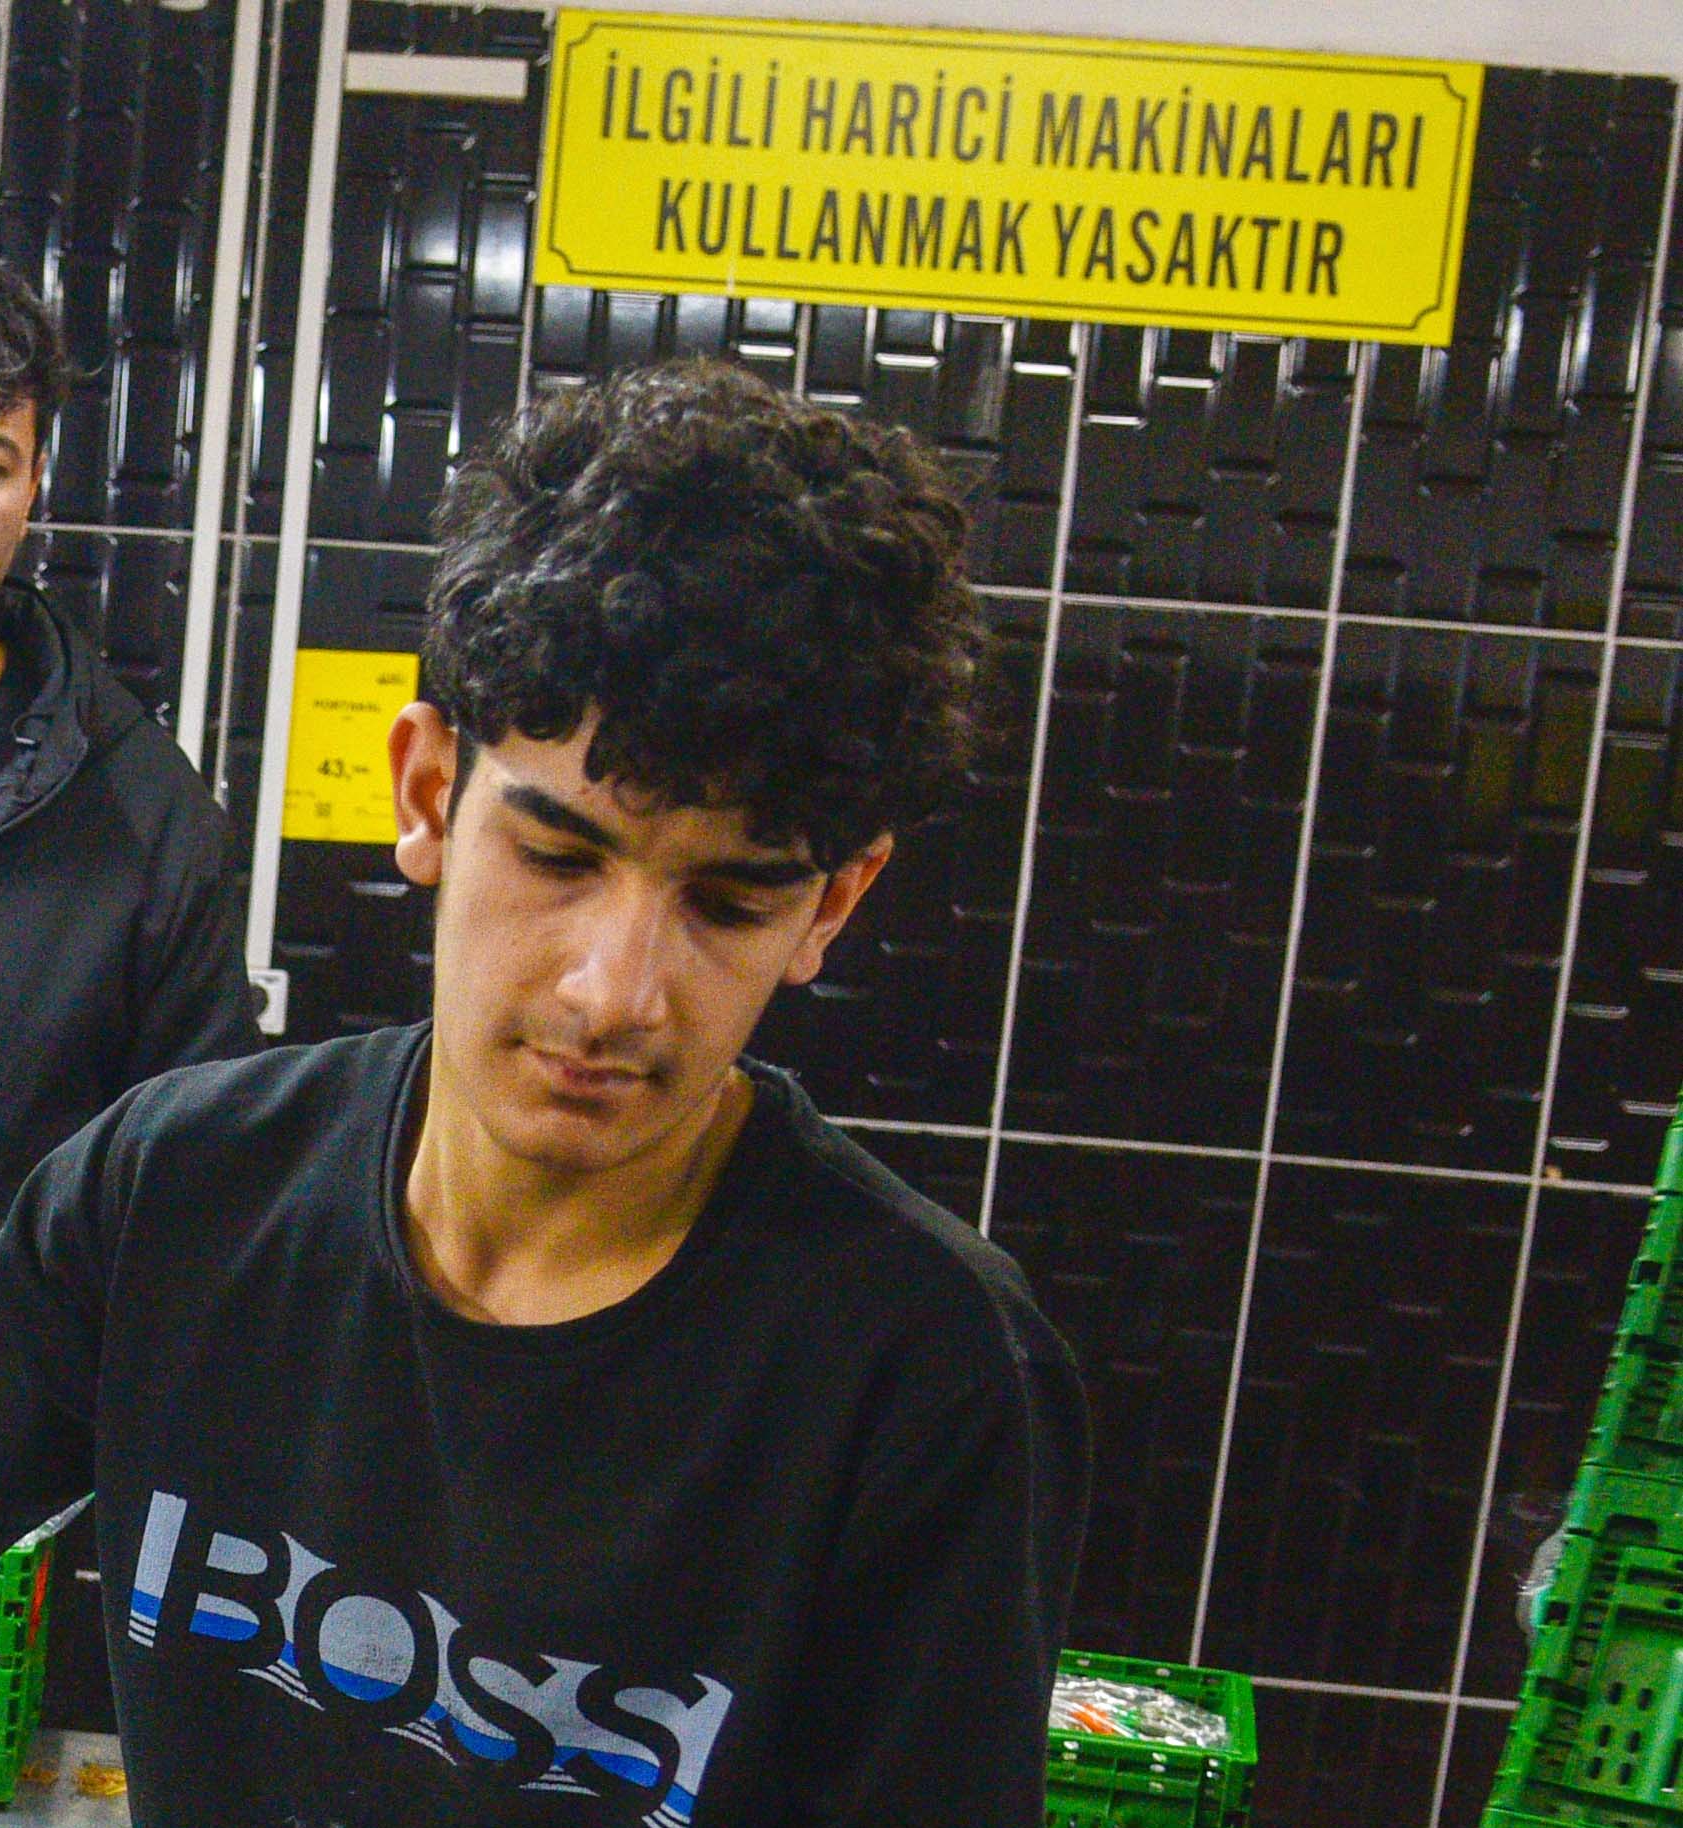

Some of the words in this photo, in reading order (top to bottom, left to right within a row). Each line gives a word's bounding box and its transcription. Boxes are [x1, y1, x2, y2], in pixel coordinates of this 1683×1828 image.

[600, 51, 779, 149] İLGİLİ
[800, 69, 1014, 166] HARİCİ
[1034, 87, 1426, 191] MAKİNALARI
[655, 179, 1031, 275] KULLANMAK
[1052, 204, 1346, 298] YASAKTIR
